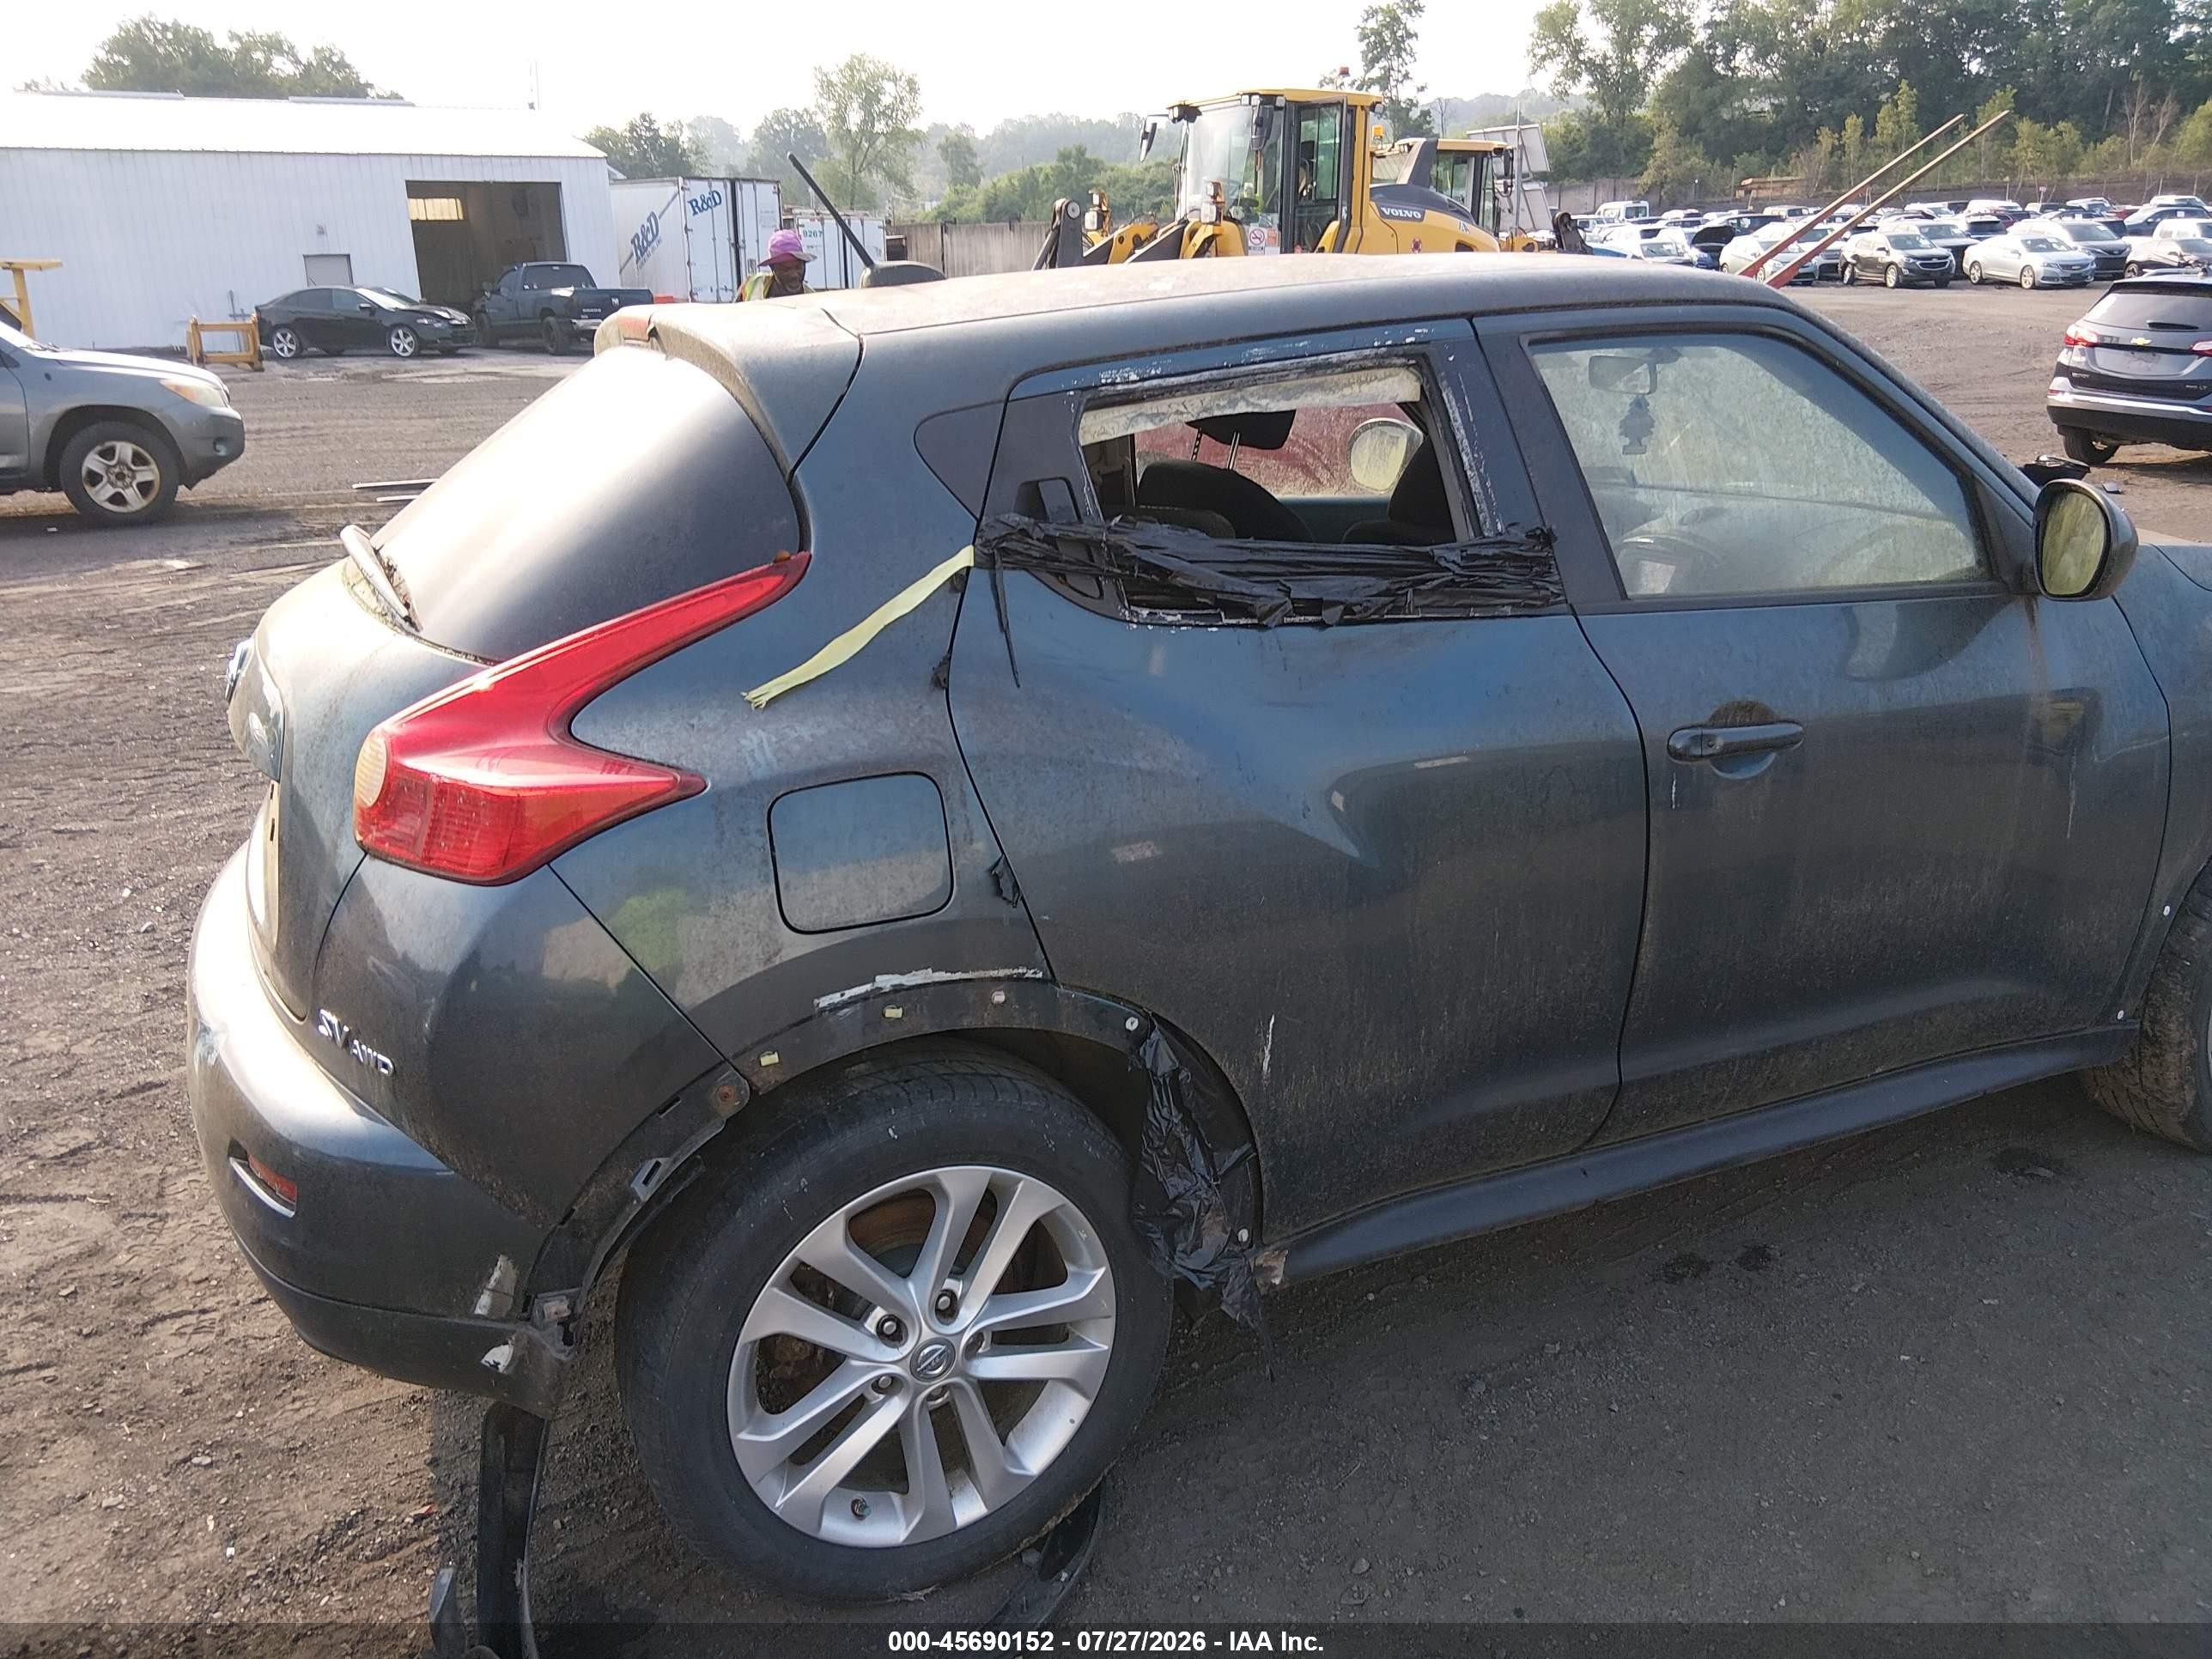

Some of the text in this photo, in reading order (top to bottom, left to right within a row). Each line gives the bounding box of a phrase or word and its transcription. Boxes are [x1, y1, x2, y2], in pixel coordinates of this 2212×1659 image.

[687, 190, 722, 216] R&D
[1380, 207, 1422, 219] VOLVO
[630, 210, 659, 264] R&D
[317, 1008, 394, 1077] SV AWD
